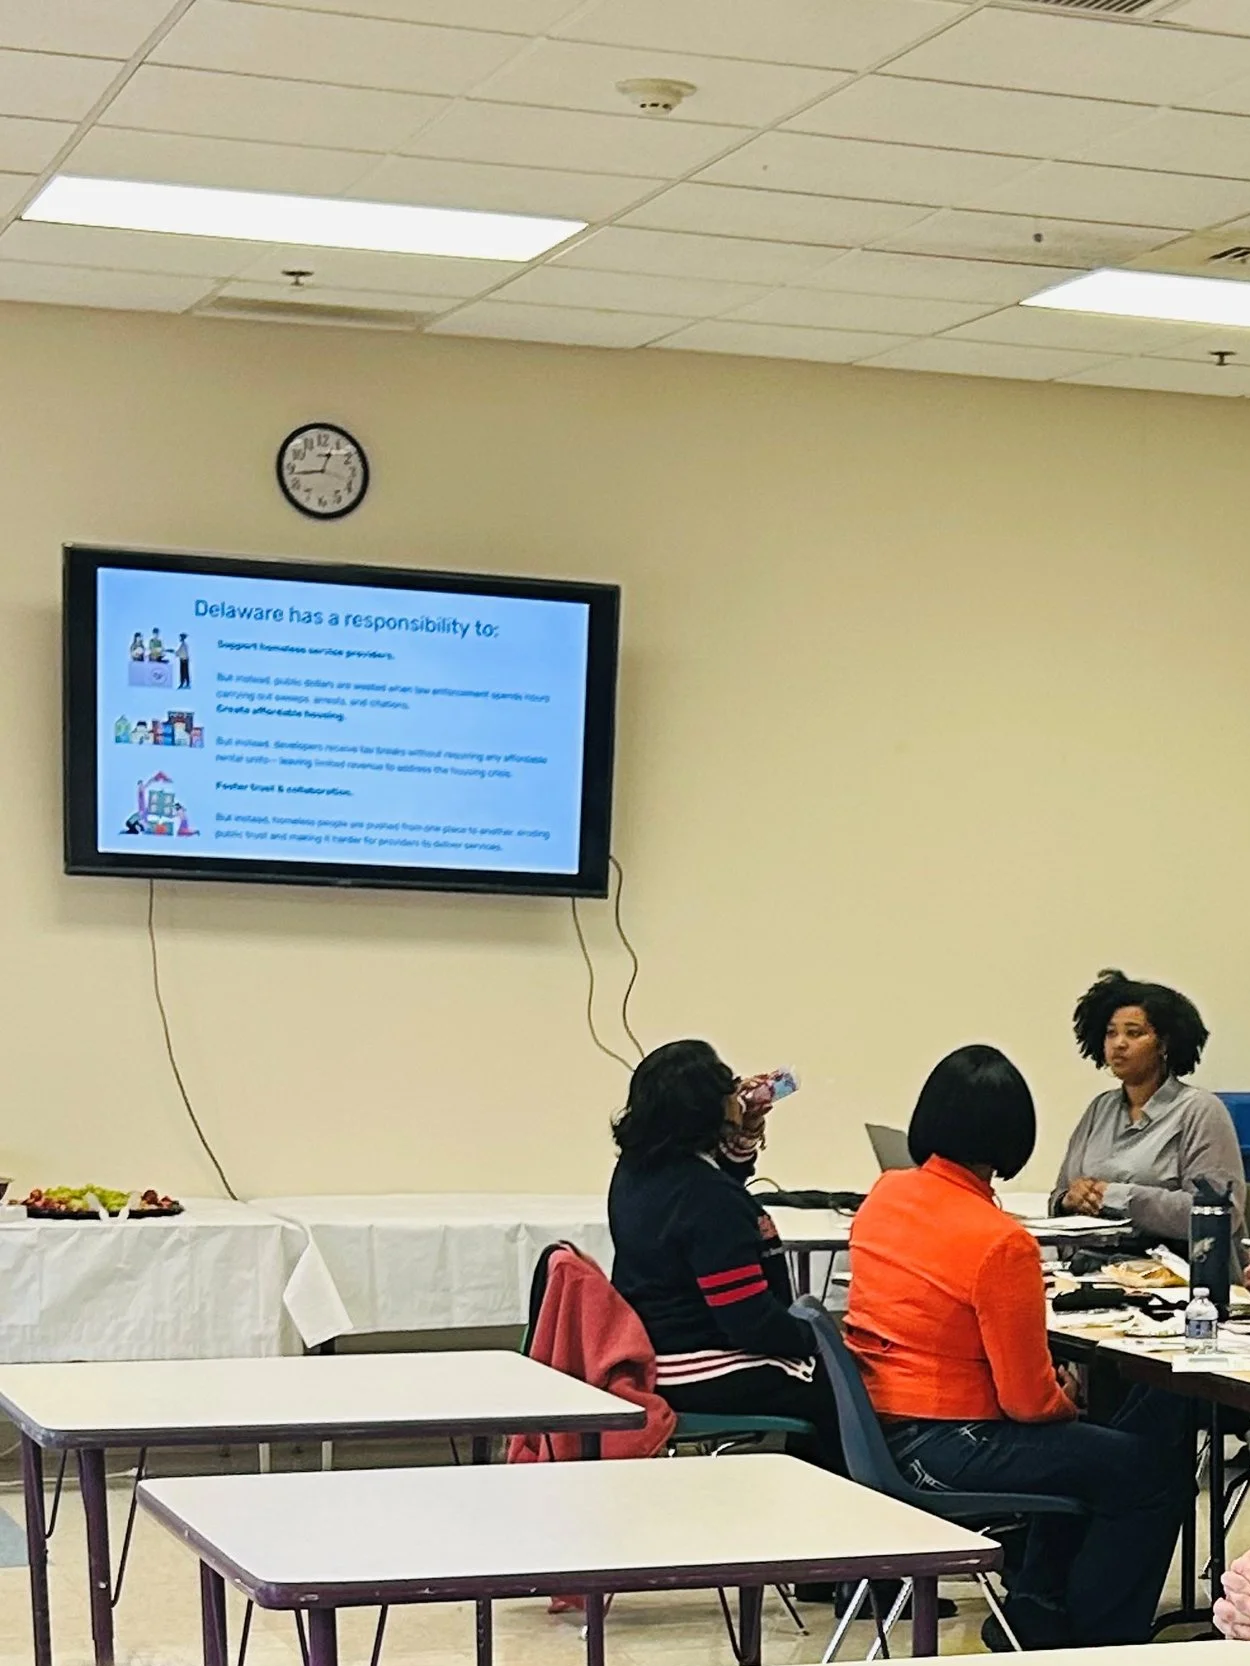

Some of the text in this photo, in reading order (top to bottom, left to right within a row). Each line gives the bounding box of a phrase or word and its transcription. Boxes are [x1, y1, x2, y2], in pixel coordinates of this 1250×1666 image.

[194, 599, 284, 623] Delaware
[289, 605, 324, 626] has
[328, 612, 340, 627] a
[343, 613, 470, 640] responsibility
